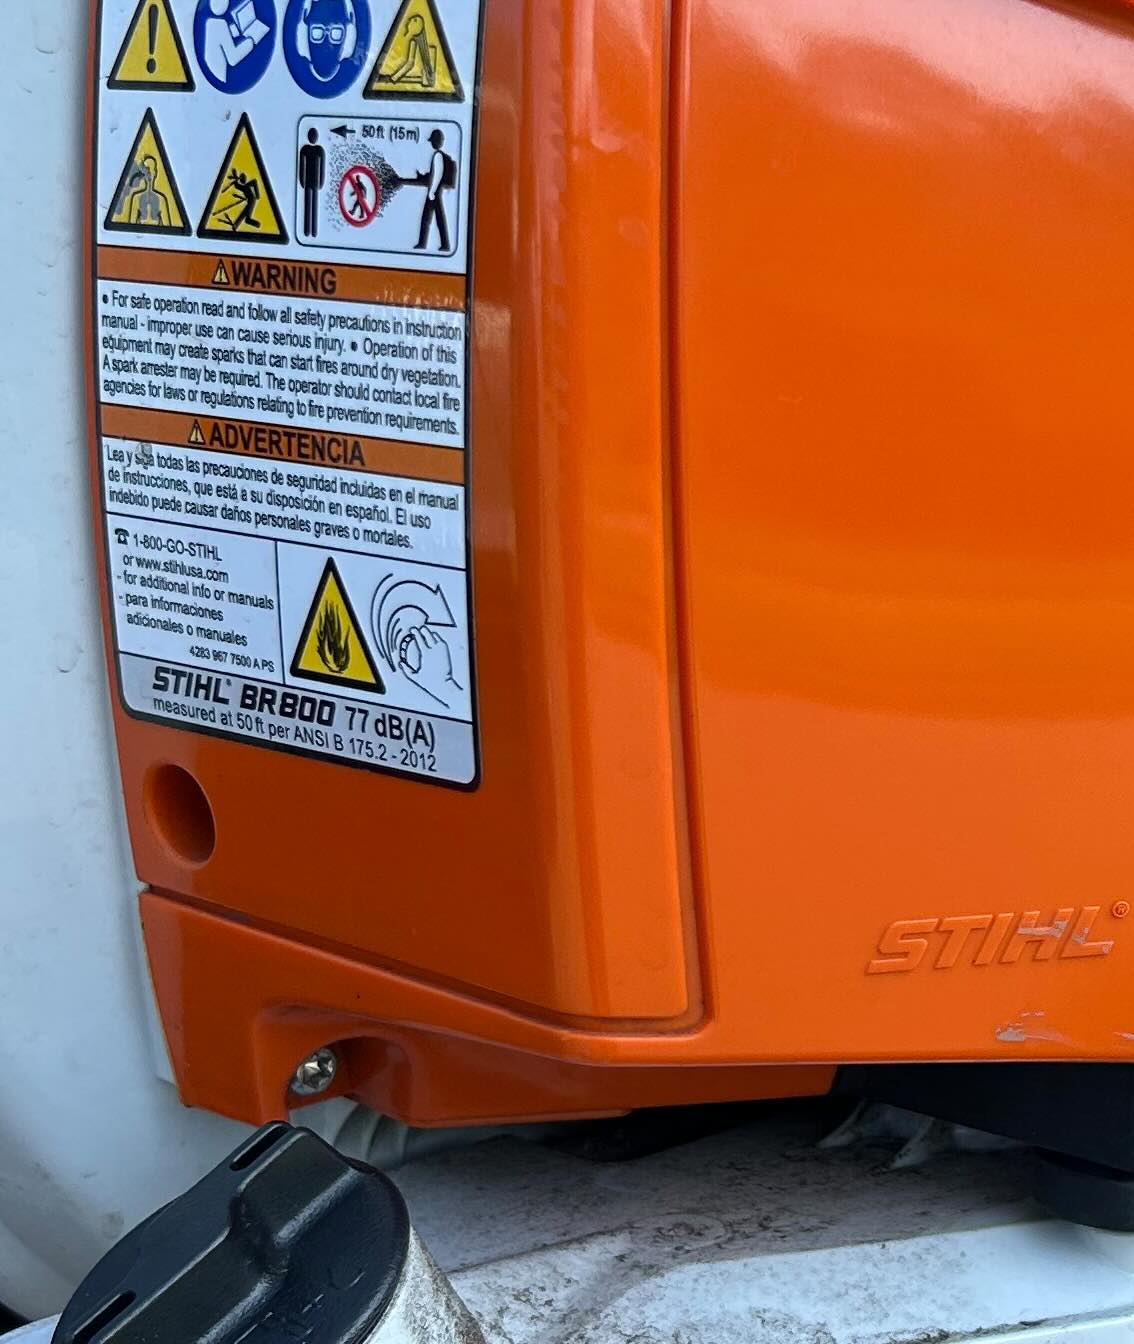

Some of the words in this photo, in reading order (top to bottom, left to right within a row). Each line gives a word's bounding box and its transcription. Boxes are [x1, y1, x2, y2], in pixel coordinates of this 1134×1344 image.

[231, 261, 337, 295] WARNING
[102, 314, 137, 330] manual
[147, 316, 193, 337] improper
[195, 323, 213, 338] use
[217, 326, 235, 341] can
[238, 329, 269, 344] cause
[273, 330, 311, 348] serious
[314, 333, 346, 356] injury.
[363, 337, 418, 360] Operation
[422, 344, 434, 361] of
[436, 345, 457, 364] this
[112, 290, 129, 307] For
[130, 293, 151, 310] safe
[154, 297, 199, 315] operation
[202, 300, 224, 317] read
[226, 303, 245, 319] and
[248, 305, 278, 322] follow
[280, 306, 292, 324] all
[295, 308, 326, 334] safety
[329, 315, 390, 334] precautions
[393, 316, 403, 333] in
[406, 319, 461, 341] instruction
[102, 336, 152, 355] equipment
[155, 341, 176, 360] may
[178, 343, 208, 356] create
[212, 345, 244, 365] sparks
[247, 349, 267, 366] that
[269, 354, 288, 369] can
[290, 355, 314, 371] start
[316, 356, 338, 374] fires
[341, 361, 378, 379] around
[381, 363, 398, 385] dry
[401, 368, 461, 388] vegetation.
[112, 357, 138, 373] spark
[140, 361, 177, 378] arrester
[180, 366, 201, 385] may
[204, 365, 217, 383] be
[219, 370, 263, 389] required.
[265, 372, 286, 391] The
[288, 378, 333, 396] operator
[334, 382, 370, 401] should
[372, 388, 412, 407] contact
[415, 388, 440, 408] local
[442, 393, 460, 411] fire
[103, 378, 146, 396] agencies
[148, 380, 162, 397] for
[163, 382, 185, 401] laws
[188, 388, 198, 401] or
[200, 390, 255, 409] regulations
[258, 395, 294, 418] relating
[297, 400, 307, 416] to
[308, 400, 325, 418] fire
[327, 405, 382, 425] prevention
[385, 413, 459, 435] requirements.
[209, 422, 366, 467] ADVERTENCIA
[108, 466, 120, 482] de
[123, 466, 191, 495] instrucciones,
[194, 481, 213, 498] que
[216, 483, 238, 500] está
[251, 489, 263, 504] su
[266, 489, 326, 513] disposición
[329, 501, 342, 517] en
[346, 504, 392, 523] español.
[396, 508, 407, 526] El
[410, 513, 431, 530] uso
[156, 452, 184, 471] todas
[185, 456, 200, 473] las
[202, 460, 268, 484] precauciones
[271, 468, 284, 485] de
[286, 472, 337, 493] seguridad
[340, 477, 386, 500] incluidas
[389, 488, 403, 502] en
[406, 487, 416, 504] el
[418, 490, 459, 510] manual
[109, 486, 149, 507] indebido
[152, 495, 182, 512] puede
[184, 502, 218, 518] causar
[221, 504, 251, 524] daños
[254, 510, 311, 533] personales
[314, 521, 350, 539] graves
[363, 528, 413, 549] mortales.
[123, 555, 135, 566] or
[136, 557, 229, 583] www.stihlusa.com
[133, 533, 222, 562] 1-800-GO-STIHL
[123, 570, 137, 585] for
[140, 573, 189, 595] additional
[192, 582, 211, 599] info
[214, 588, 226, 600] or
[228, 592, 274, 611] manuals
[125, 593, 148, 607] para
[150, 594, 224, 622] informaciones
[127, 612, 184, 635] adicionales
[196, 628, 247, 647] manuales
[262, 659, 275, 672] PS
[152, 697, 216, 723] measured
[221, 713, 233, 727] at
[268, 722, 290, 740] per
[294, 725, 330, 748] ANSI
[334, 734, 344, 751] B
[349, 738, 388, 761] 175.2
[401, 748, 437, 772] 2012
[240, 683, 336, 727] BR800
[345, 705, 369, 733] 77
[374, 713, 435, 753] dB(A)
